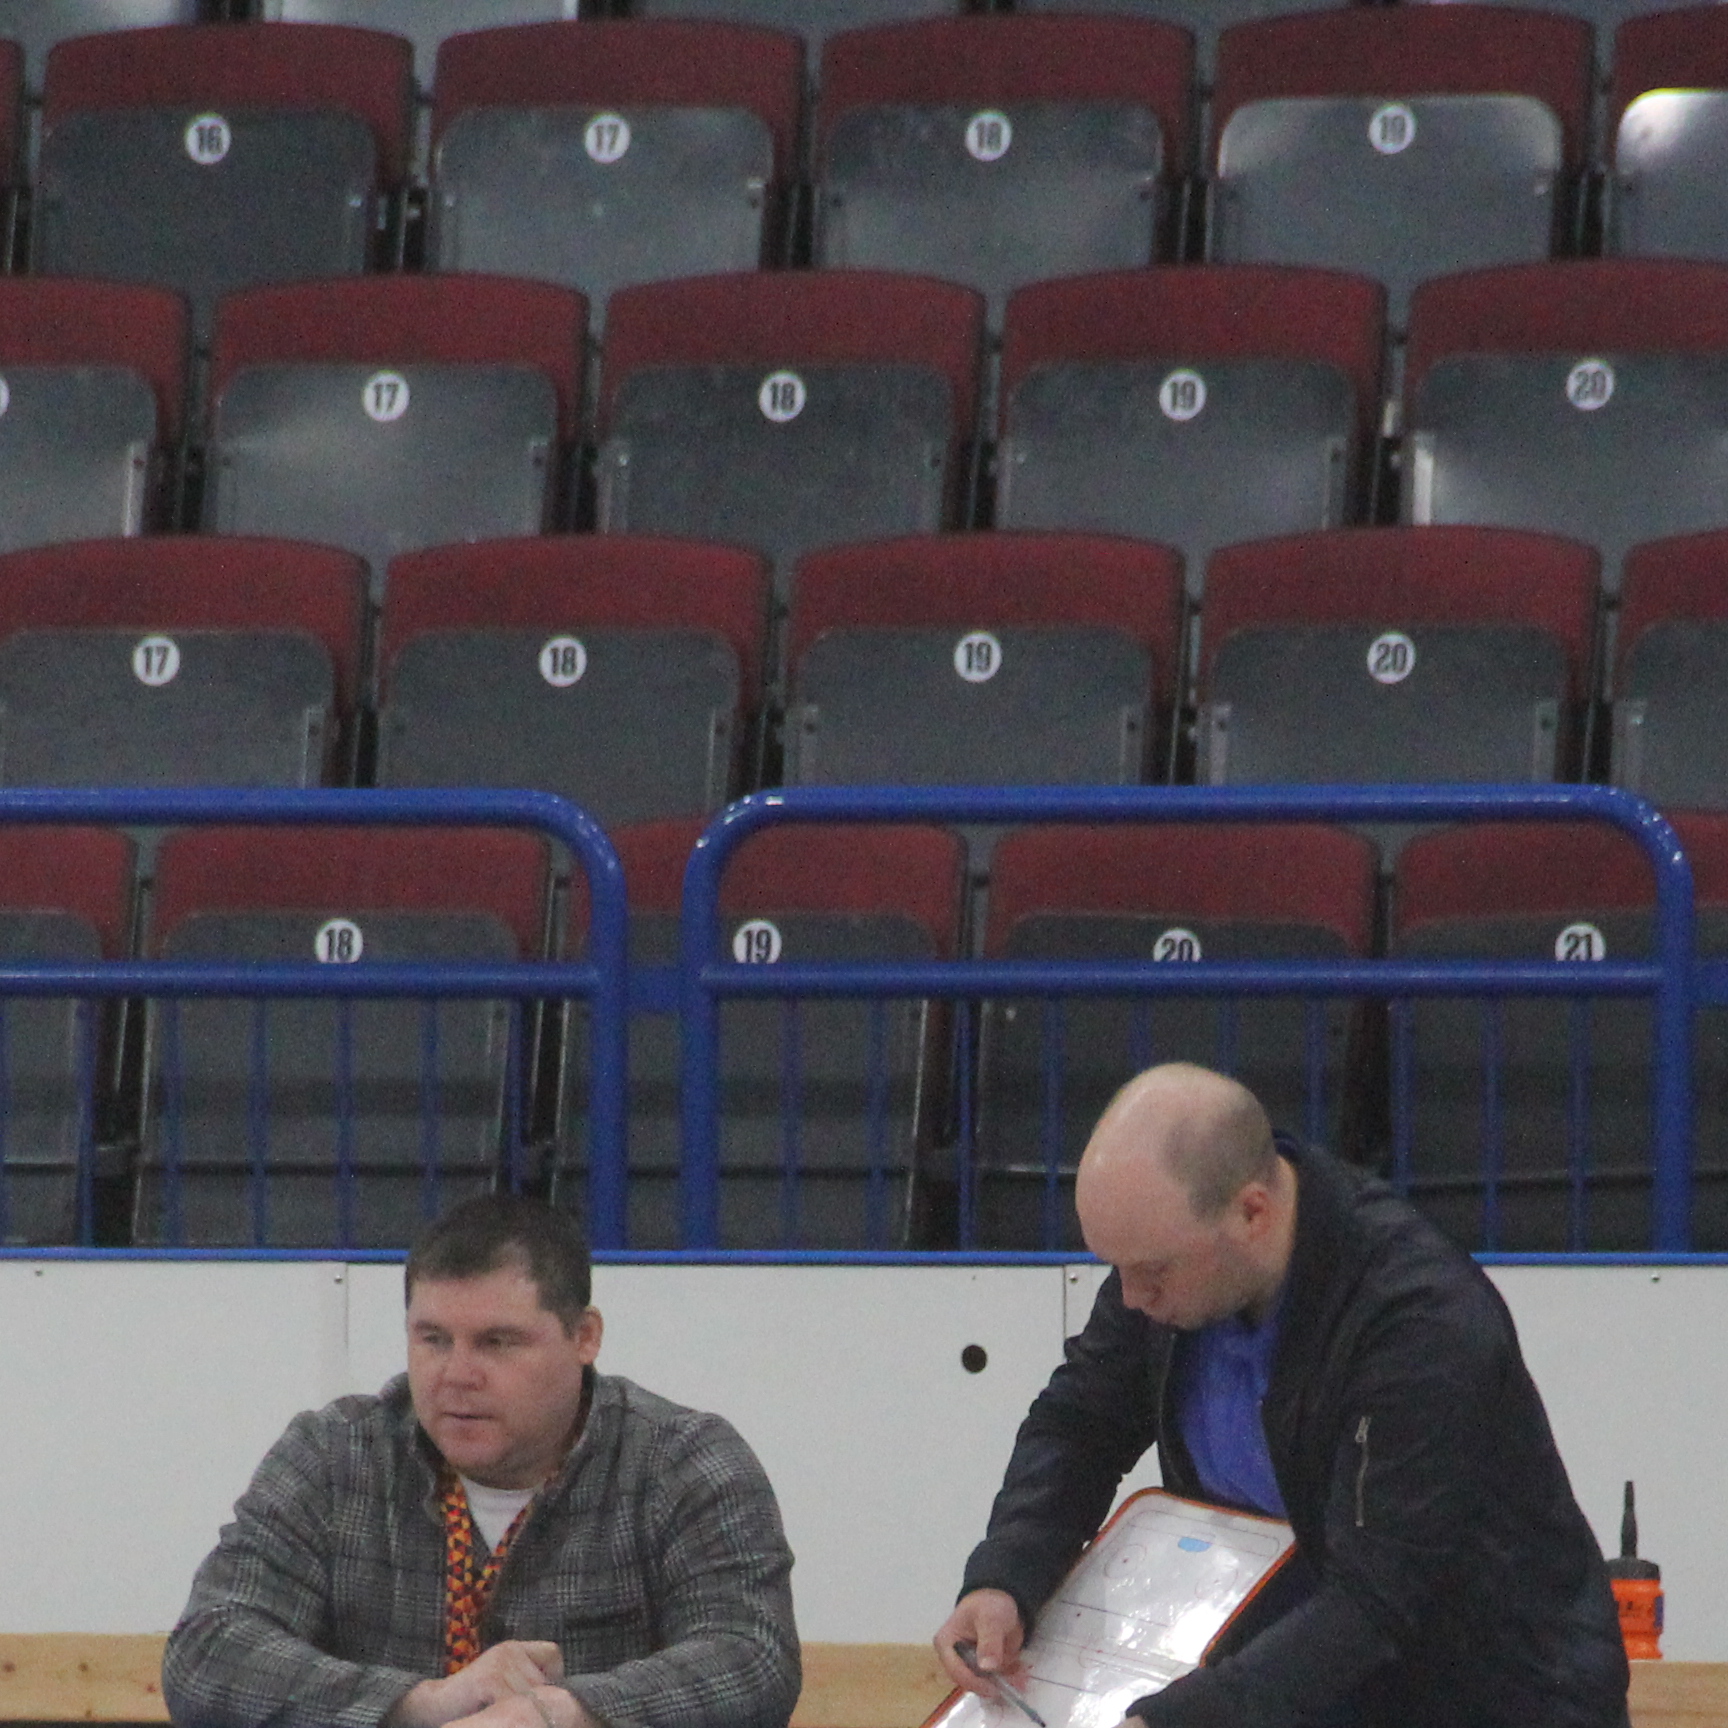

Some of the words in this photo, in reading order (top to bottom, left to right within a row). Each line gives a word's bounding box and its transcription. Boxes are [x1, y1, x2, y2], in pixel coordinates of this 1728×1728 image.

[197, 125, 222, 153] 16
[595, 123, 620, 152] 17
[373, 381, 399, 410] 17
[770, 382, 796, 412] 18
[1170, 380, 1197, 409] 19
[1575, 370, 1607, 399] 20
[143, 645, 169, 675] 17
[551, 646, 577, 675] 18
[965, 641, 992, 672] 19
[1375, 642, 1408, 673] 20
[326, 928, 353, 961] 18
[745, 929, 772, 961] 19
[1162, 938, 1194, 960] 20
[1565, 933, 1593, 960] 21
